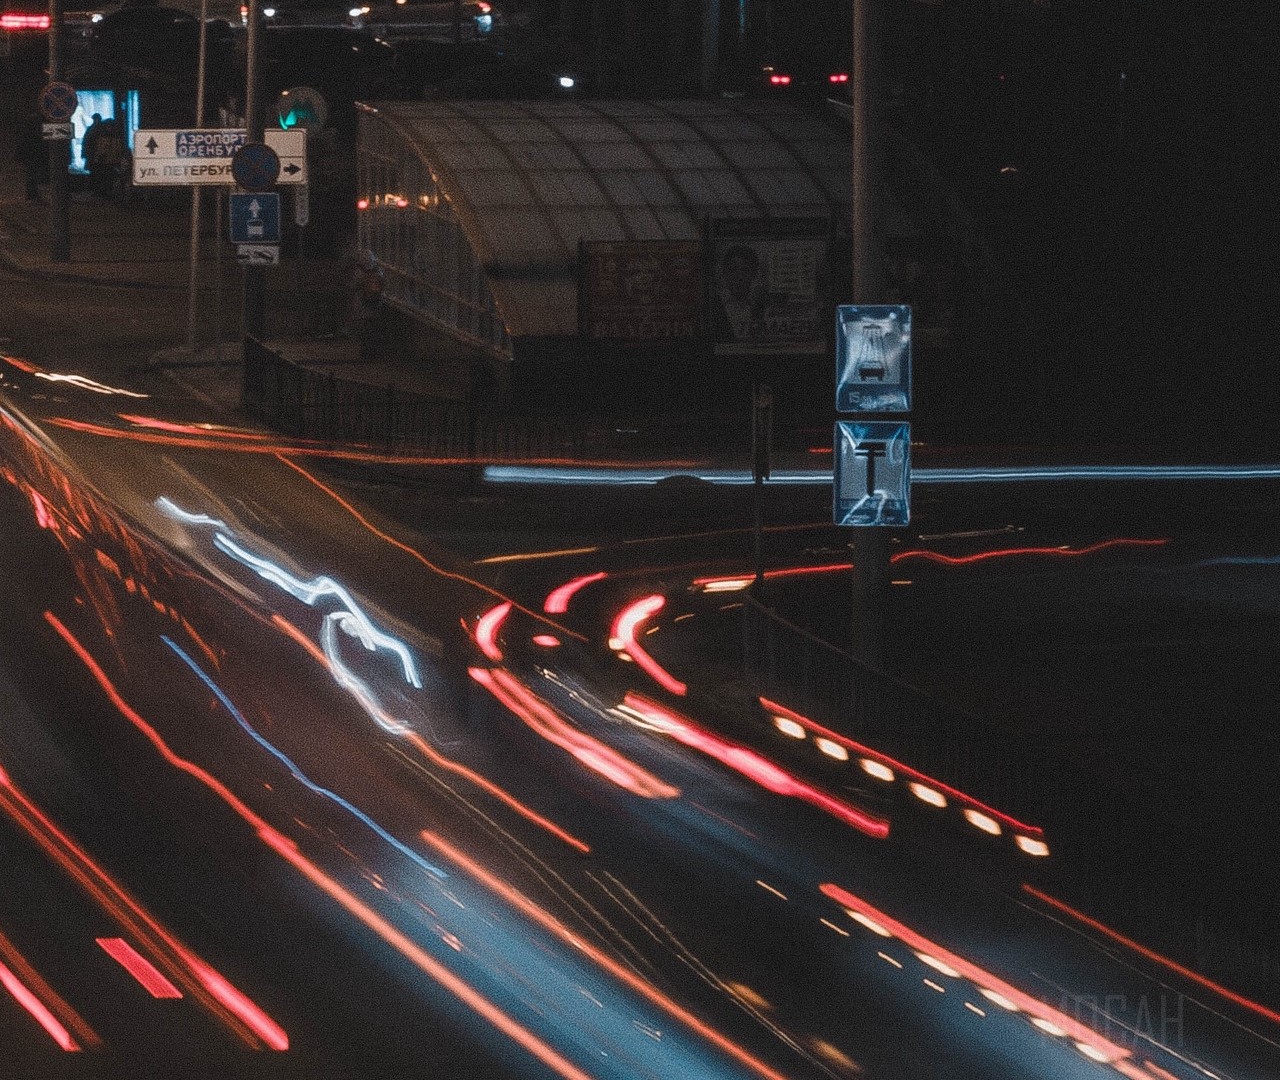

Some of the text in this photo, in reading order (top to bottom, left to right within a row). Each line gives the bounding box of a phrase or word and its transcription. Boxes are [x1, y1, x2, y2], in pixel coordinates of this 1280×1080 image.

[178, 133, 248, 145] АЭРОПОРТ
[178, 145, 242, 157] ОРЕНБУ
[140, 165, 233, 178] ул. ПЕТЕРБУР
